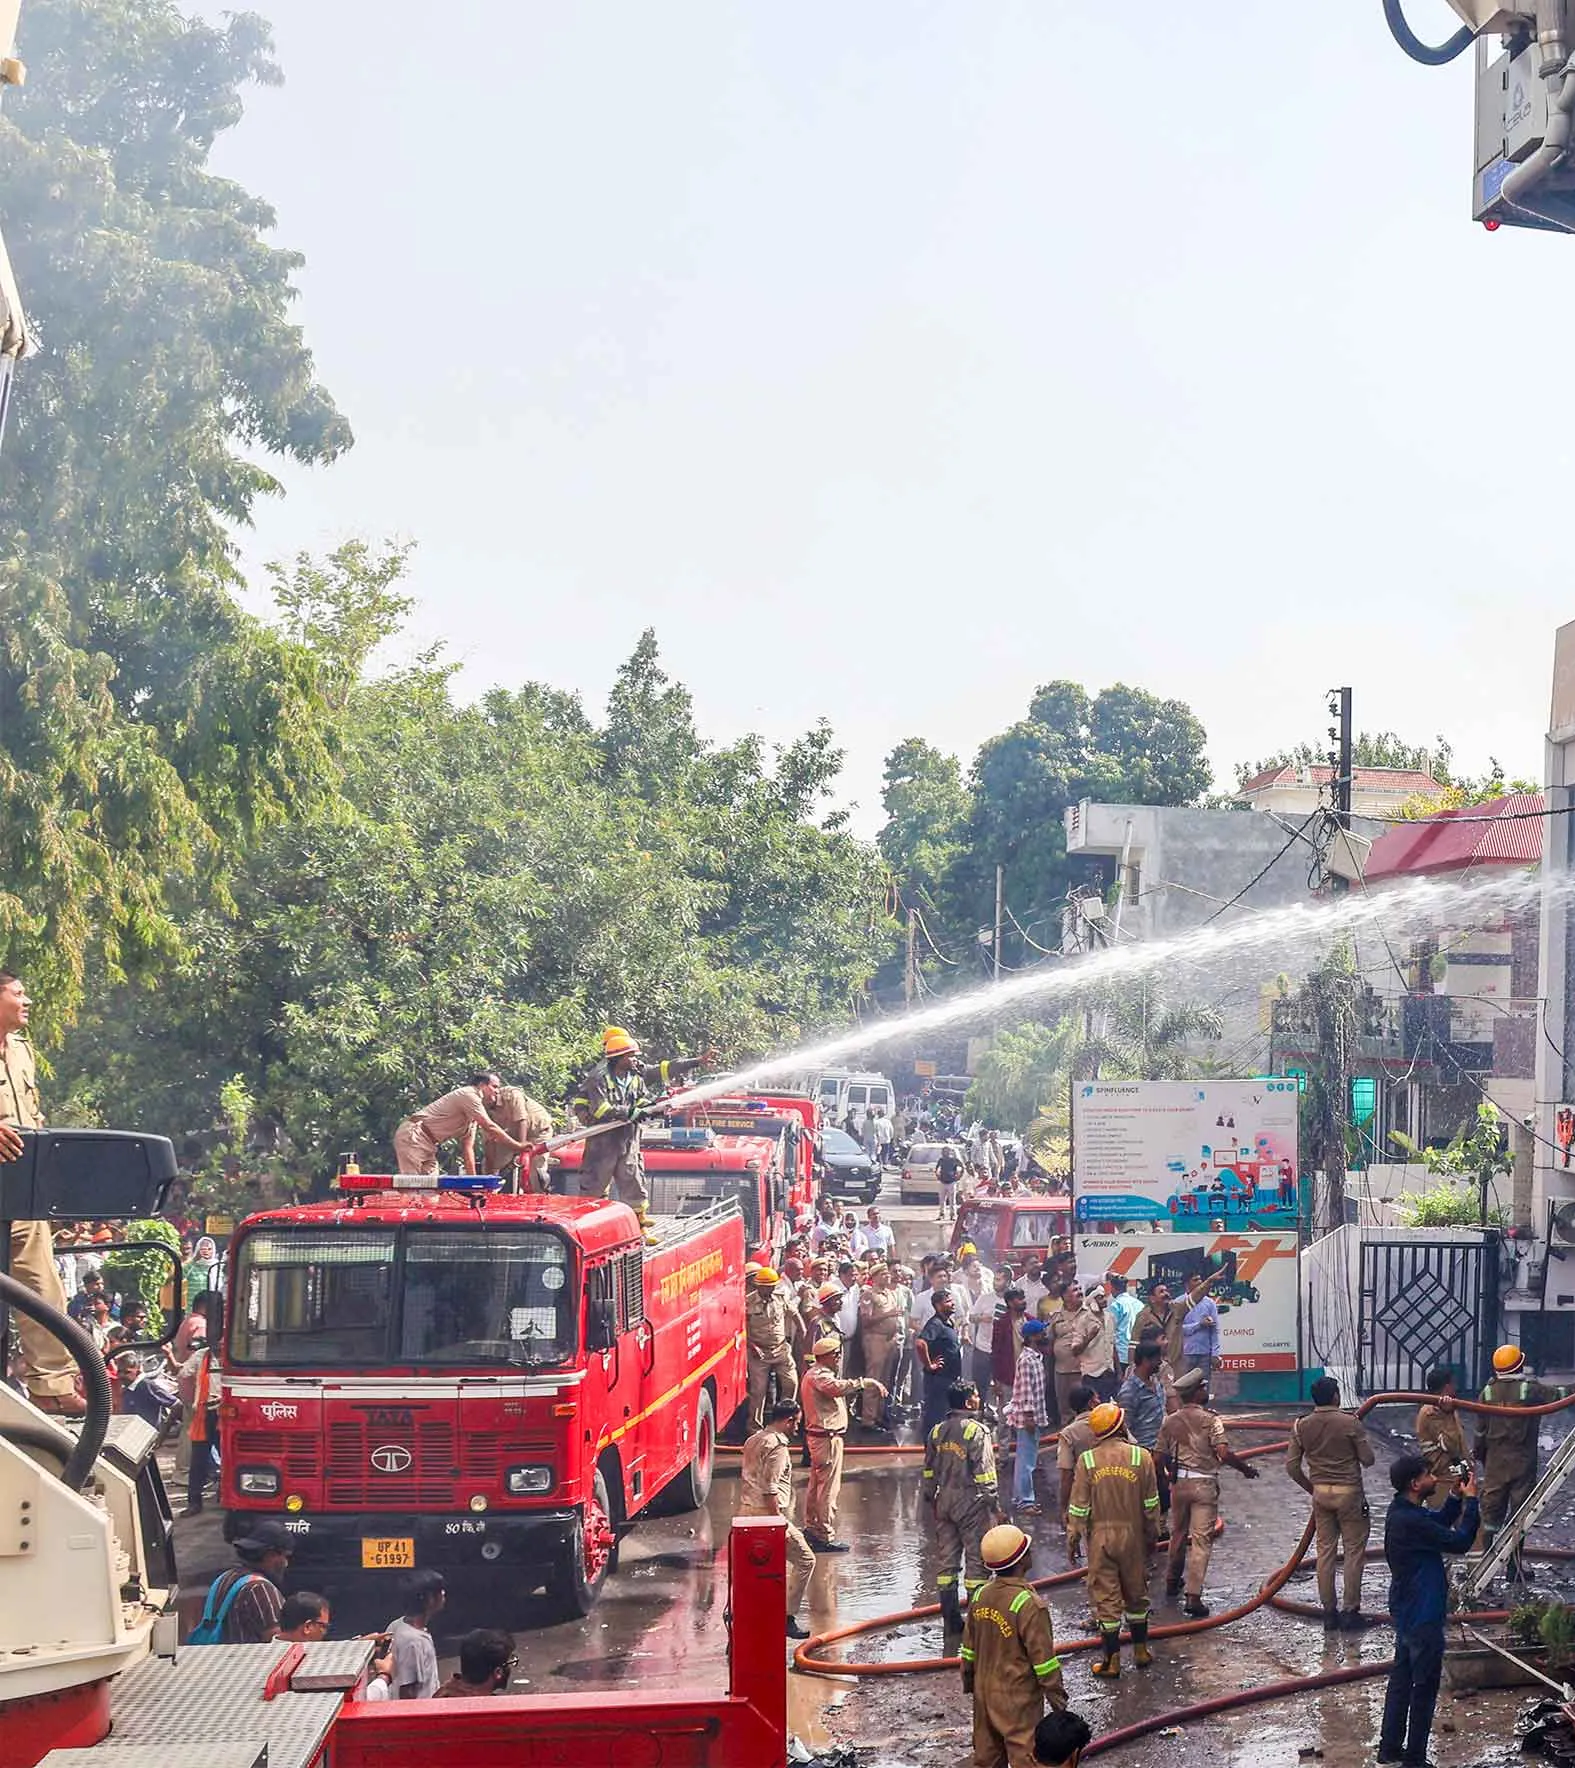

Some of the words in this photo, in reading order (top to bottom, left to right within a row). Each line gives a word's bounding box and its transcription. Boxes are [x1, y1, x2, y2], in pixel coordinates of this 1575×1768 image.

[1223, 1328, 1255, 1337] GAMING
[260, 1401, 298, 1421] पुलिस
[377, 1541, 391, 1552] UP
[394, 1541, 406, 1552] 41
